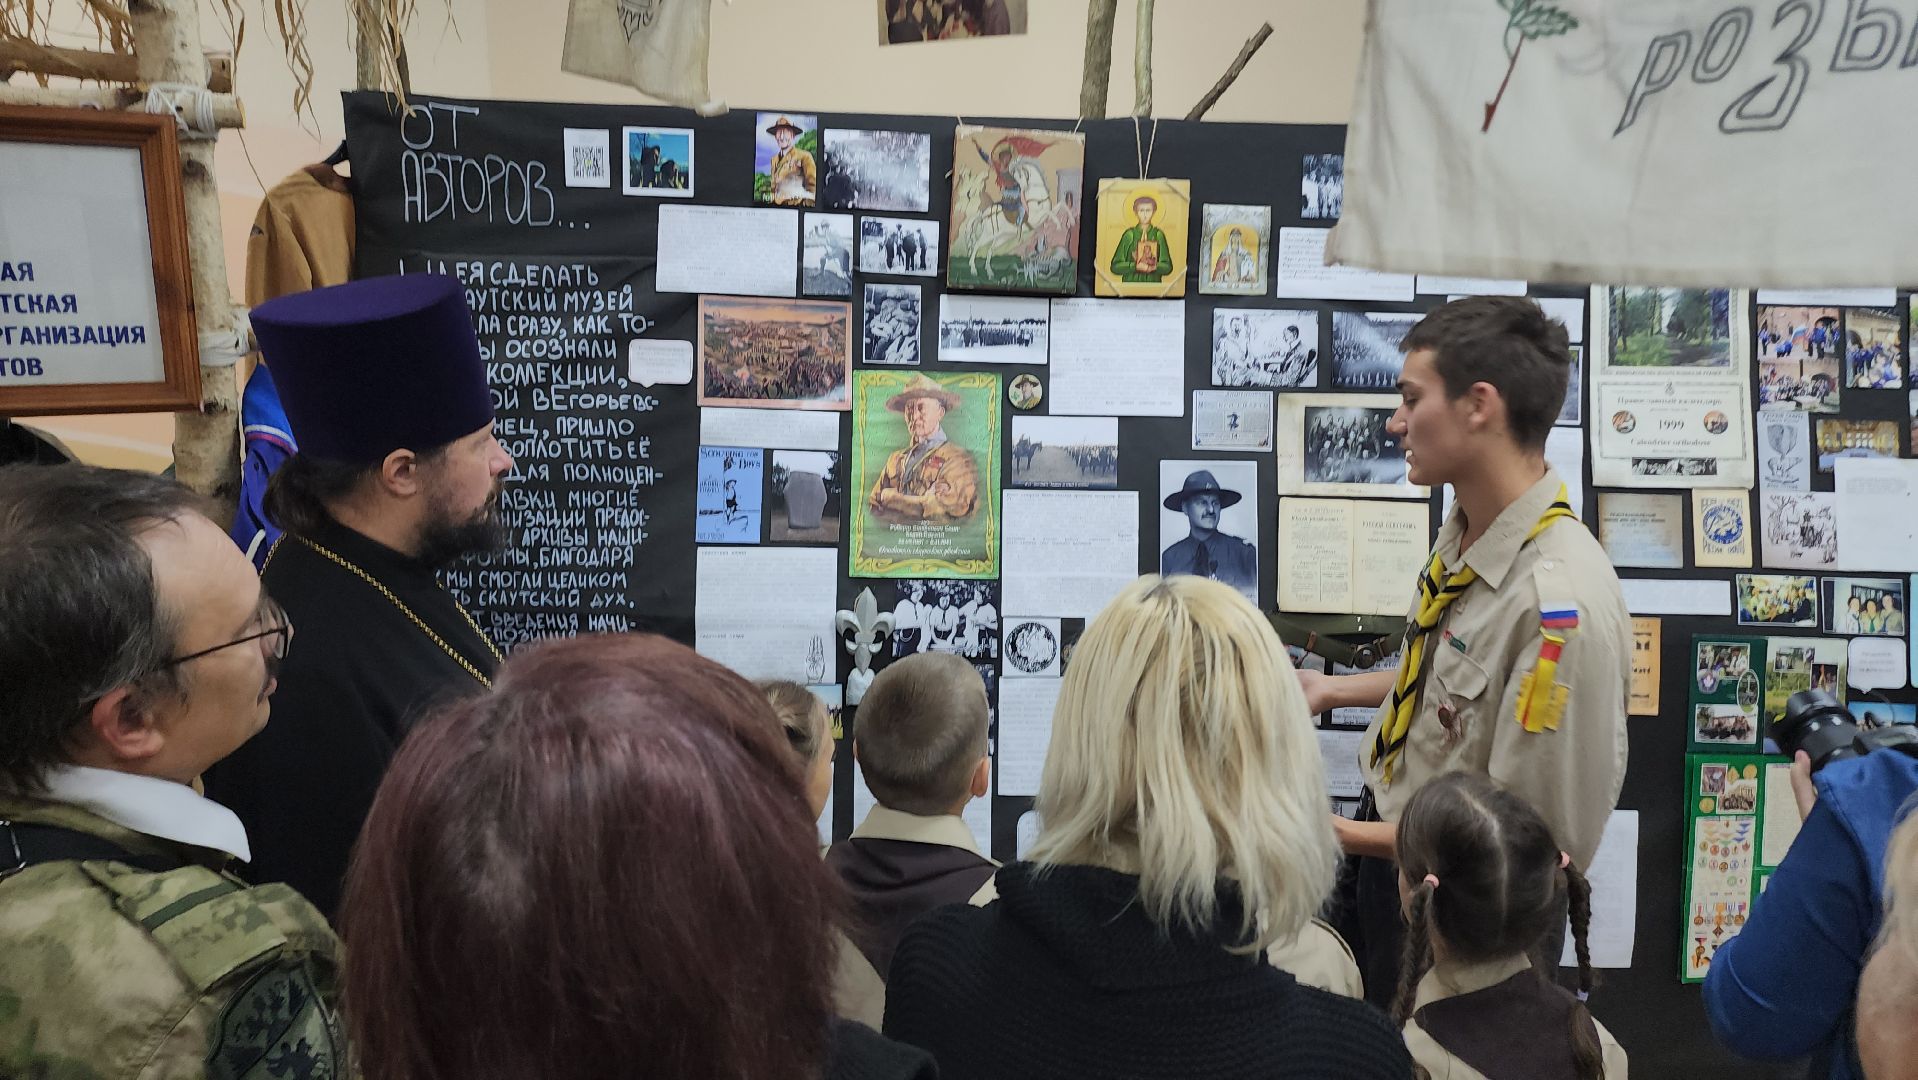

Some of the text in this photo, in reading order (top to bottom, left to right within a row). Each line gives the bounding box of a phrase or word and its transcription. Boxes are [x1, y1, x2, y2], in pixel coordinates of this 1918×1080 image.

[401, 101, 479, 150] ОТ
[1, 262, 34, 282] АЯ
[490, 261, 599, 287] СДЕЛАТЬ
[0, 294, 78, 314] ТСКАЯ
[465, 284, 633, 312] АУТСКИЙ МУЗЕЙ
[0, 326, 146, 347] ГАНИЗАЦИЯ
[474, 315, 500, 335] ЛА
[507, 315, 567, 339] СРАЗУ,
[574, 315, 613, 335] КАК
[478, 340, 496, 360] Ы
[505, 339, 617, 360] ОСОЗНАЛИ
[0, 358, 43, 377] ТОВ
[490, 386, 519, 410] ОЙ
[493, 416, 635, 440] НЕЦ, ПРИШЛО
[1659, 419, 1684, 430] 1999
[502, 461, 549, 484] ДЛЯ
[502, 489, 639, 511] АВКИ МНОГИЕ
[498, 509, 586, 529] НИЗАЦИИ
[522, 527, 588, 547] АРХИВЫ
[447, 571, 627, 592] МЫ СМОГЛИ ЦЕЛИКОМ
[479, 589, 580, 607] СКАУТСКИЙ
[491, 610, 578, 630] ВВЕДЕНИЯ
